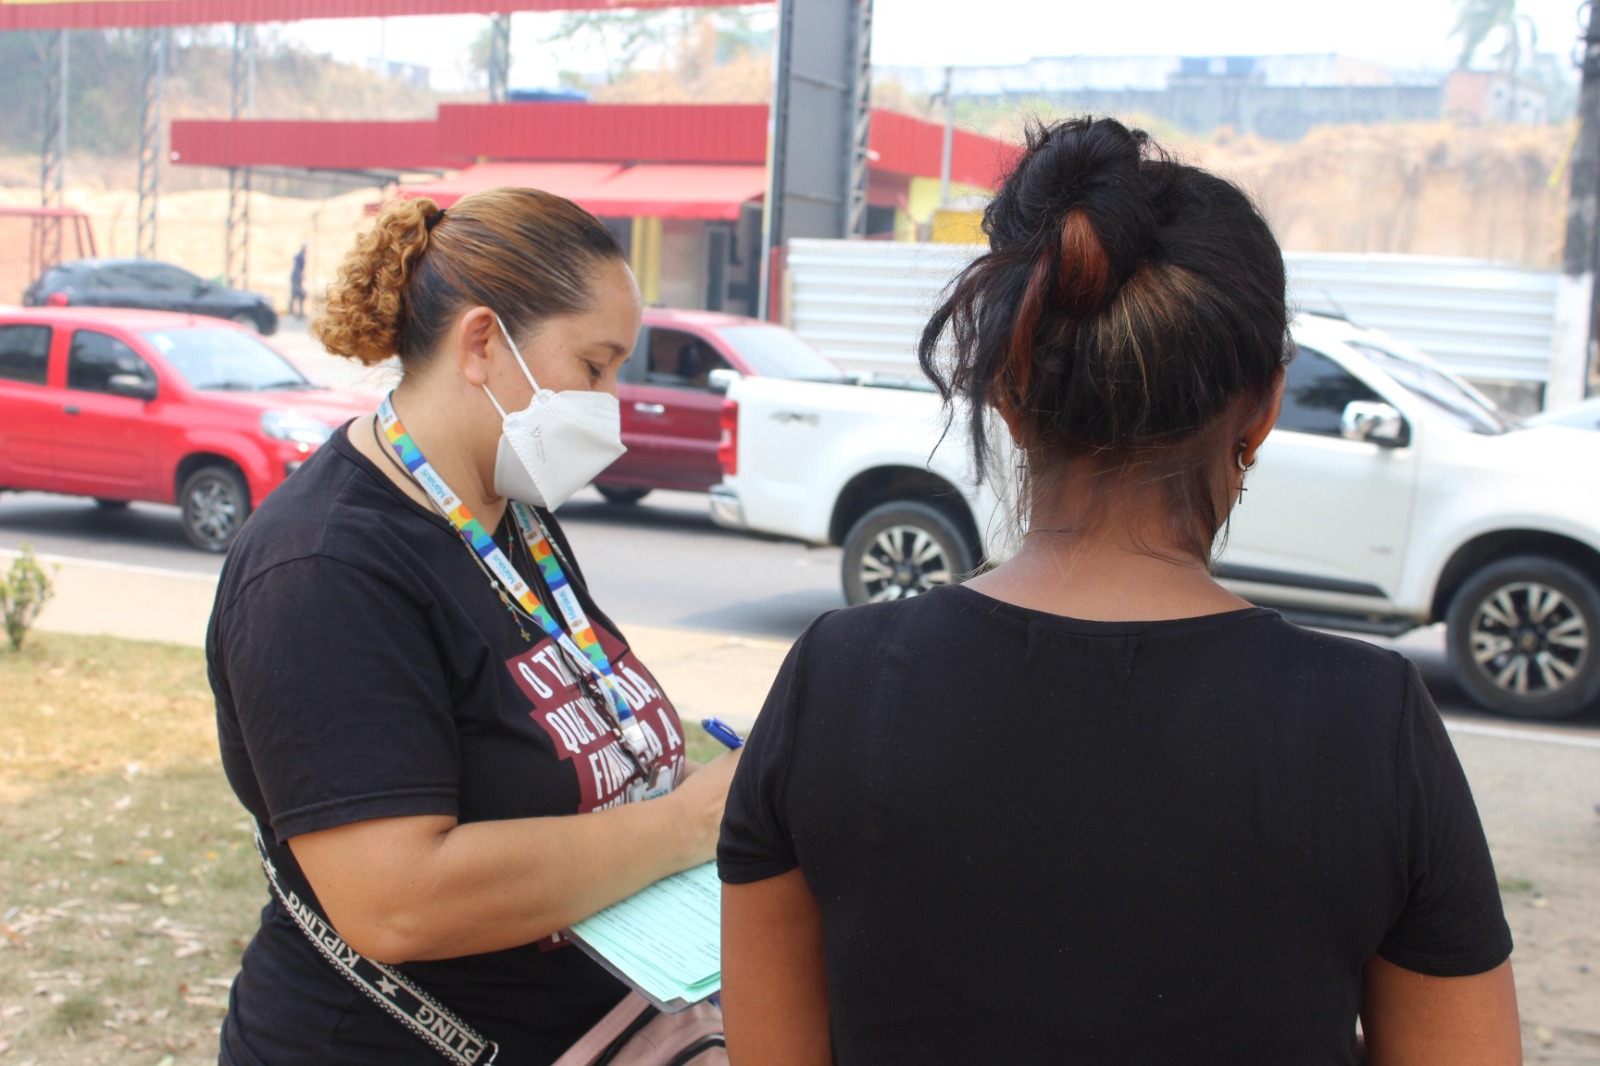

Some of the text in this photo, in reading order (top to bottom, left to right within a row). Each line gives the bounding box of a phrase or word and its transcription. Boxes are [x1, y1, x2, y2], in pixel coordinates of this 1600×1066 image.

[421, 468, 447, 498] Manaus
[492, 554, 516, 584] Manaus
[559, 591, 577, 620] Manaus
[517, 661, 554, 699] O
[657, 707, 682, 751] A
[288, 890, 360, 968] KIPLING
